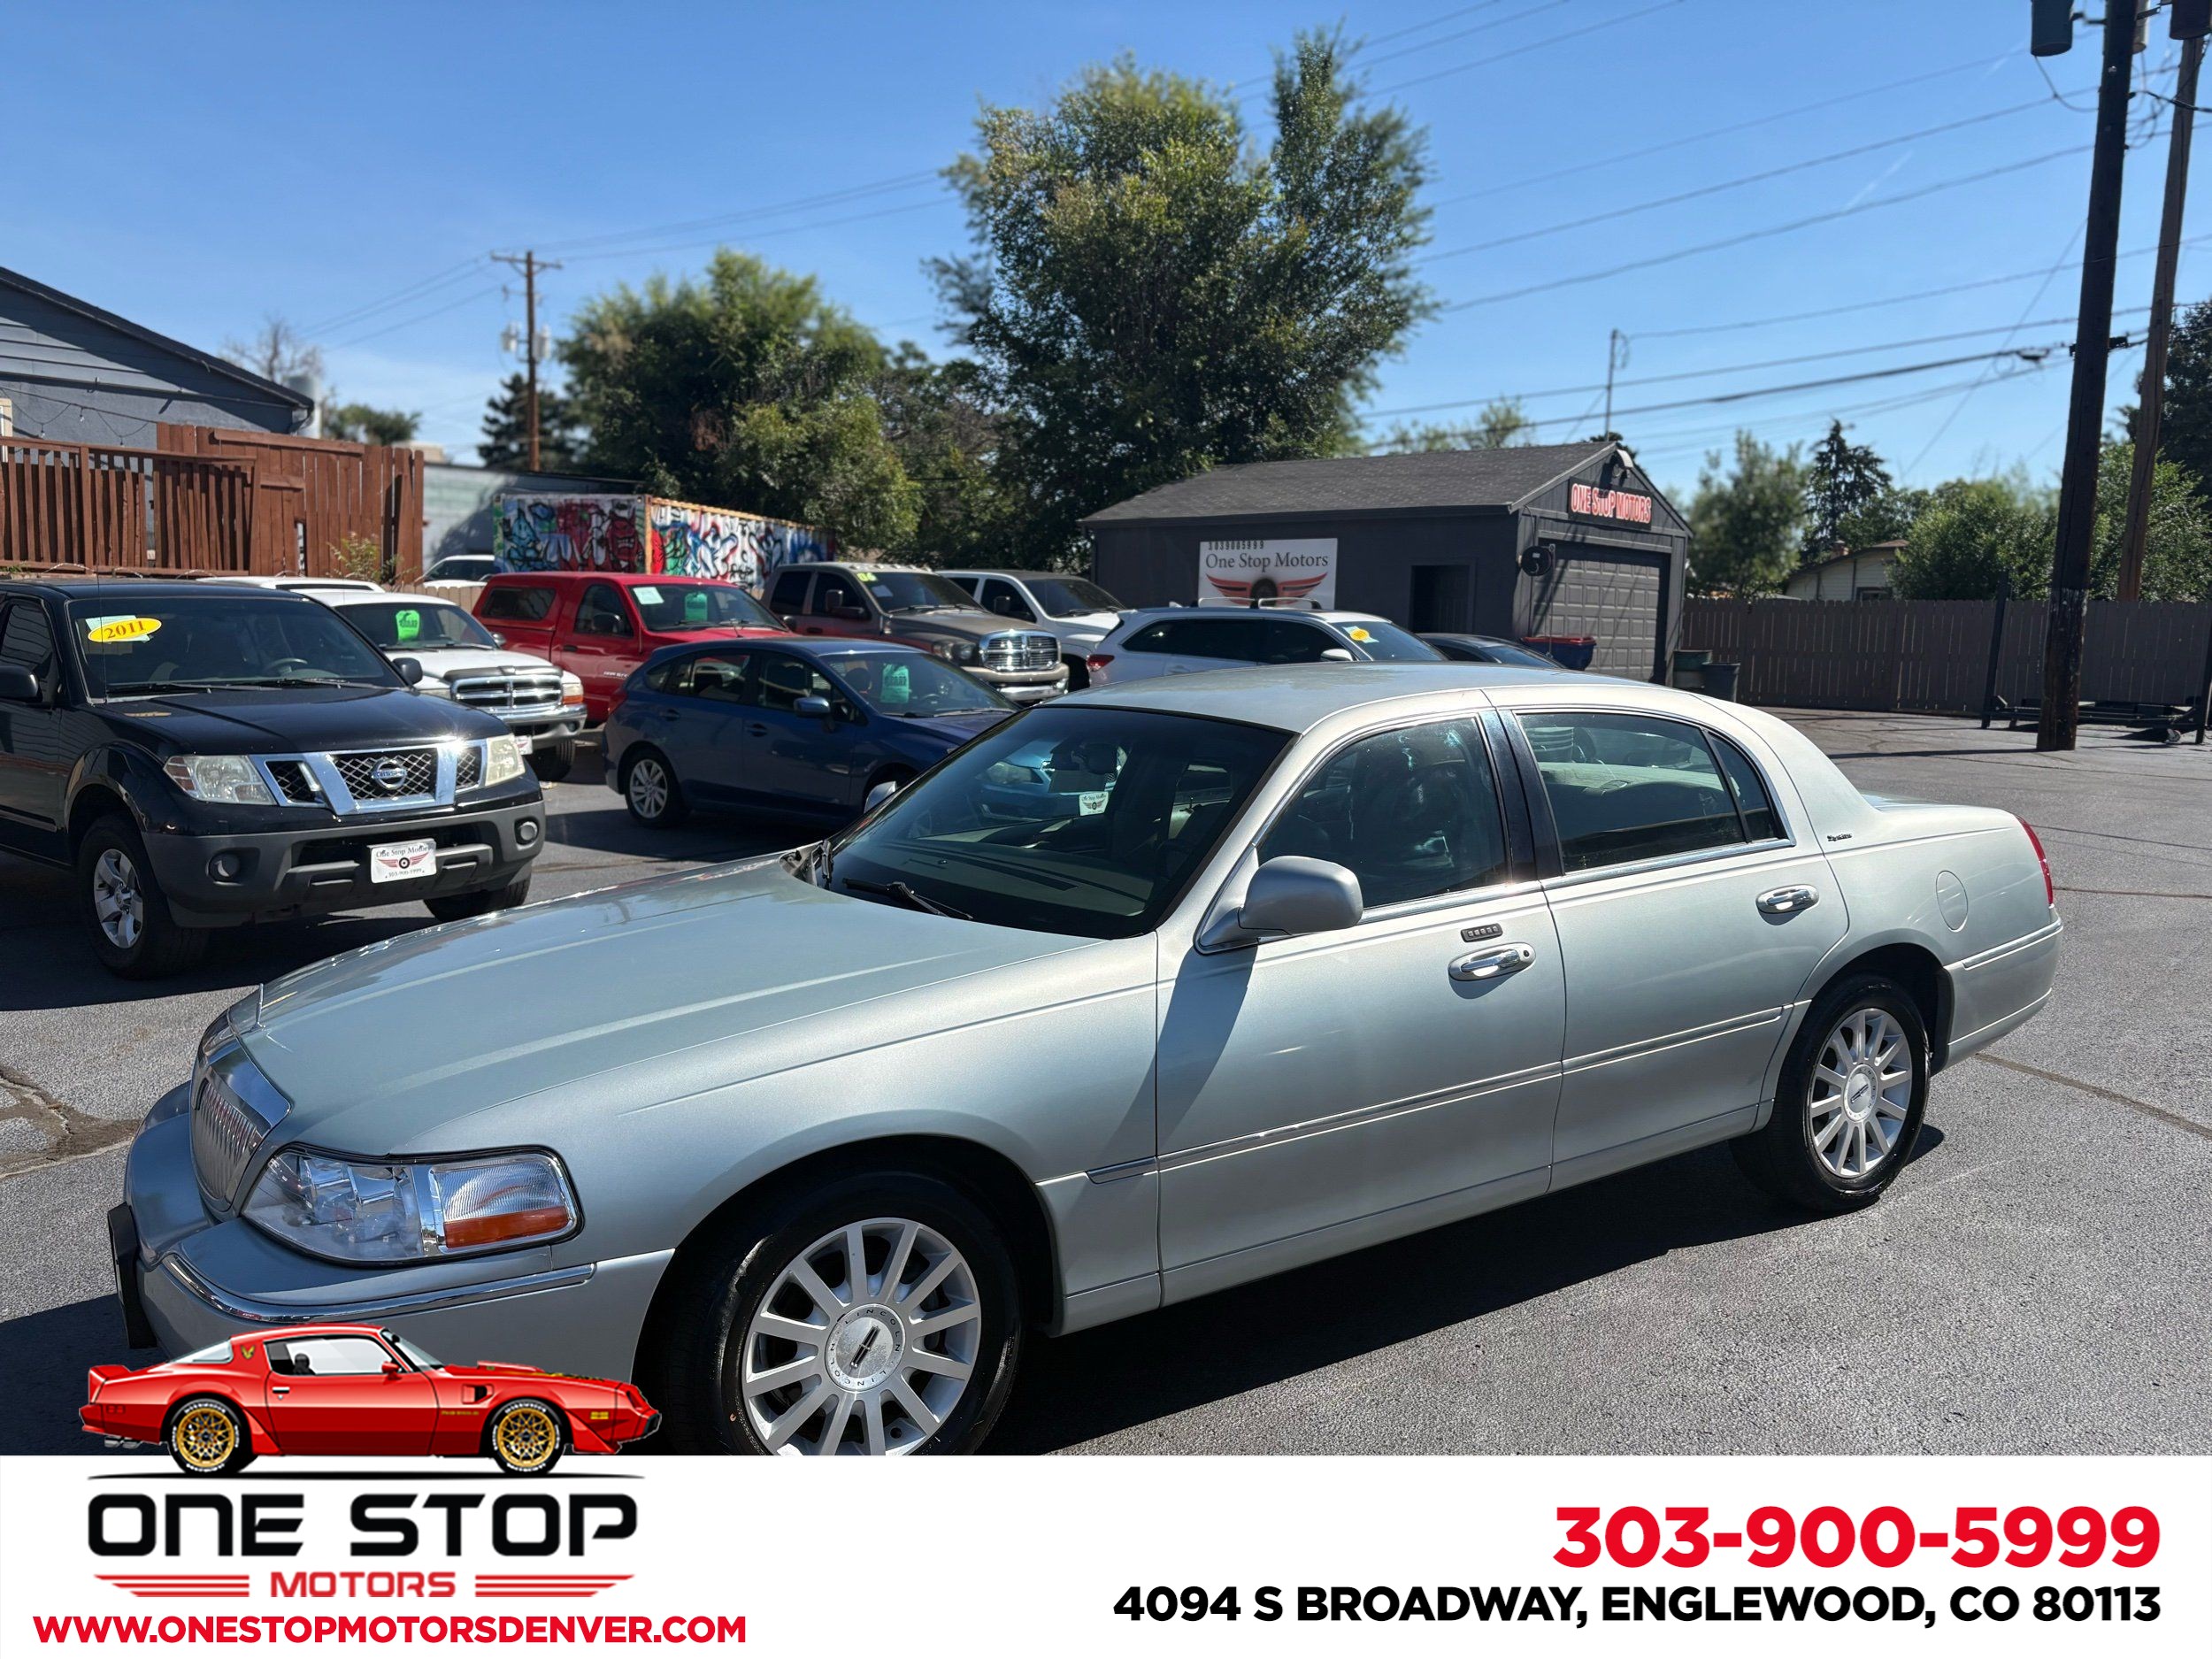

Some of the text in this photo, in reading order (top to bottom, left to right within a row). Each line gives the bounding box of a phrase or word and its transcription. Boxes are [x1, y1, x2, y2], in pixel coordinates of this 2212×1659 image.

[1571, 483, 1652, 524] ONE STOP MOTORS
[1206, 552, 1328, 572] One Stop Motors
[104, 621, 145, 638] 2011
[845, 1309, 901, 1352] LINCOLN
